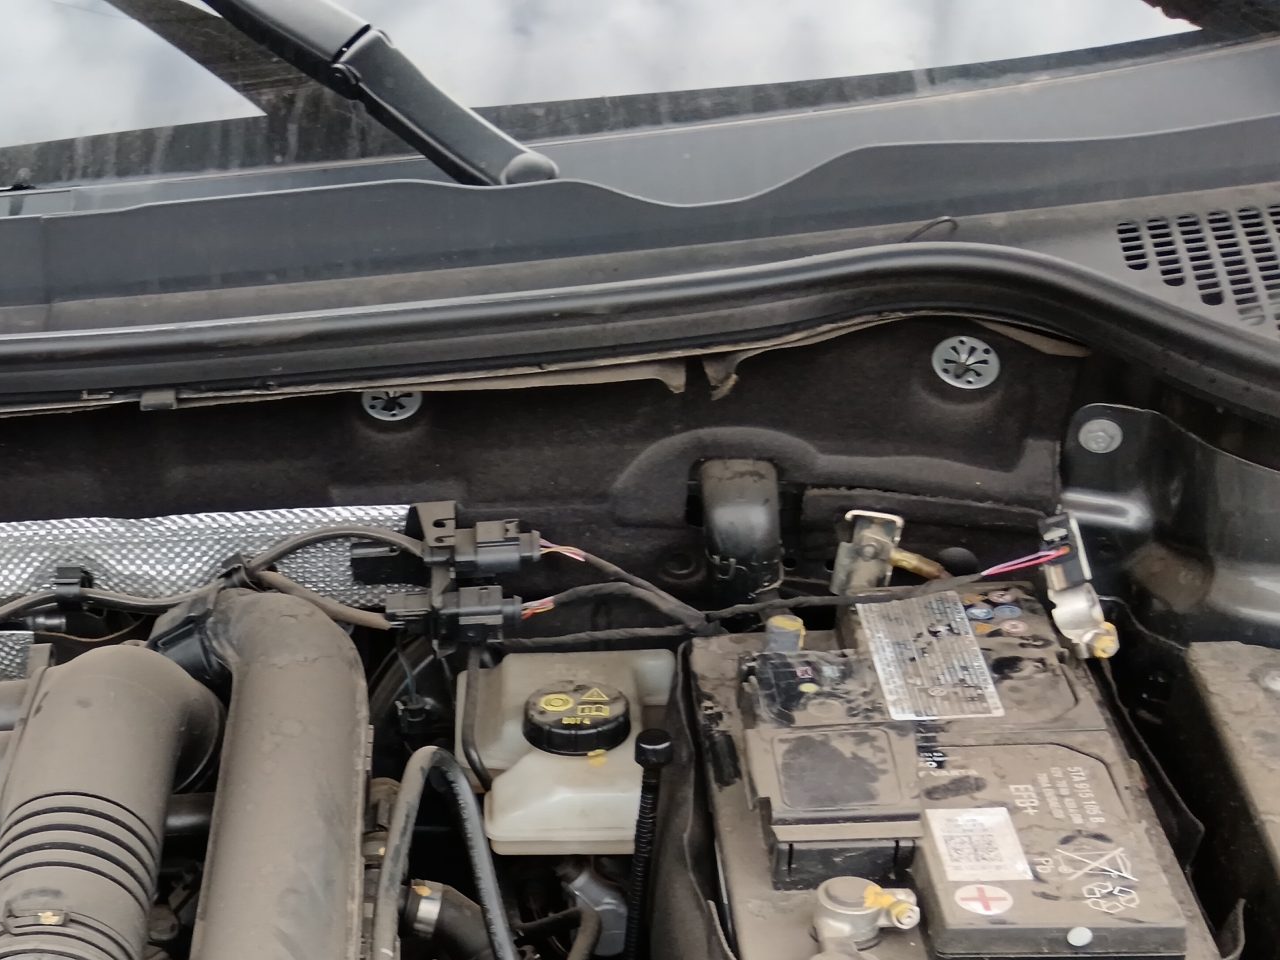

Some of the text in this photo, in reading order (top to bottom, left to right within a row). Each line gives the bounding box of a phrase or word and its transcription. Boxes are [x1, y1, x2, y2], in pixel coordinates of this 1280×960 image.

[562, 716, 581, 724] DOT
[1066, 766, 1087, 781] 5TA
[1073, 783, 1095, 797] 915
[1009, 784, 1039, 816] EFB+
[1082, 800, 1102, 815] 105
[1033, 857, 1054, 873] Pb
